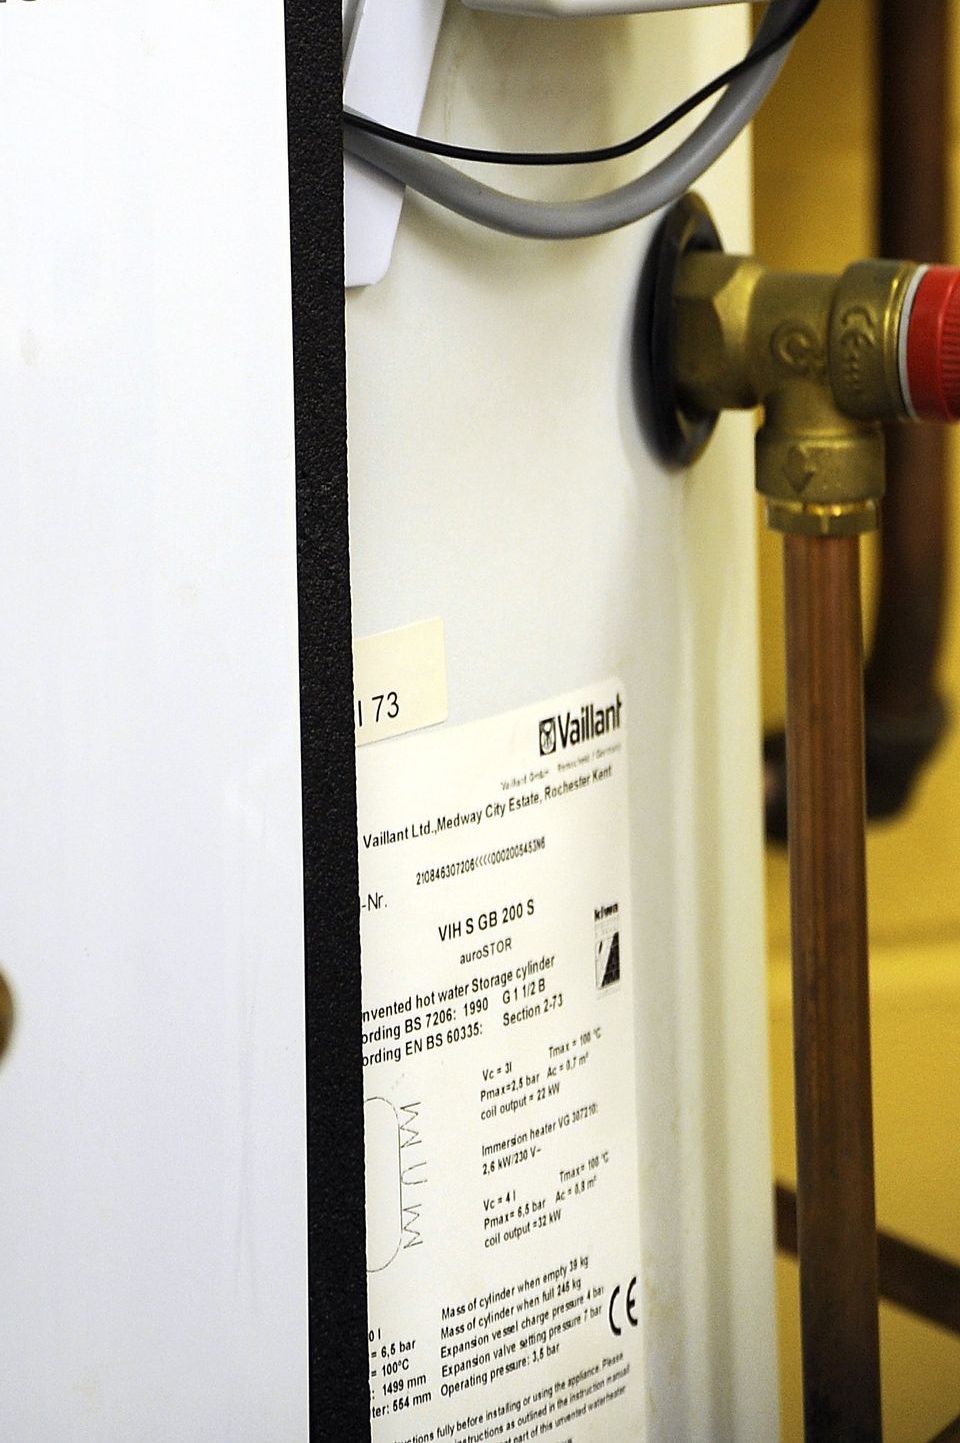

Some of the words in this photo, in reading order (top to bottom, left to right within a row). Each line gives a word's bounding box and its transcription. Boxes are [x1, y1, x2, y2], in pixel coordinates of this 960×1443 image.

[371, 691, 399, 723] 73
[557, 692, 622, 749] Vaillant
[363, 827, 409, 848] Vaillant
[485, 802, 506, 819] City
[509, 792, 542, 812] Estate,
[545, 775, 590, 800] Rochester
[592, 765, 612, 783] Kent
[438, 921, 461, 942] VIH
[465, 918, 474, 935] S
[478, 911, 498, 931] GB
[502, 903, 523, 923] 200
[527, 898, 535, 915] S
[460, 938, 512, 965] auroSTOR
[415, 991, 435, 1010] hot
[438, 984, 469, 1003] water
[471, 970, 513, 992] Storage
[516, 955, 555, 980] cylinder
[502, 990, 511, 1005] G
[514, 987, 518, 1001] 1
[522, 981, 535, 998] 1/2
[538, 978, 546, 993] B
[404, 1016, 422, 1034] BS
[426, 1007, 456, 1028] 7206:
[464, 997, 488, 1017] 1990
[503, 1004, 540, 1027] Section
[543, 993, 563, 1013] 2-73
[405, 1038, 423, 1056] EN
[426, 1033, 443, 1050] BS
[482, 1068, 495, 1081] Vc
[526, 1073, 540, 1087] bar
[481, 1105, 497, 1120] coil
[500, 1096, 527, 1114] output
[481, 1134, 528, 1157] Immersion
[530, 1121, 556, 1140] heater
[558, 1114, 570, 1129] VG
[483, 1199, 495, 1211] Vc
[532, 1198, 546, 1213] bar
[484, 1233, 501, 1248] coil
[503, 1222, 531, 1242] output
[441, 1305, 466, 1321] Mass
[468, 1297, 477, 1312] of
[480, 1286, 515, 1309] cylinder
[517, 1277, 540, 1293] when
[542, 1265, 567, 1283] empty
[580, 1256, 589, 1269] kg
[440, 1324, 465, 1340] Mass
[467, 1316, 476, 1331] of
[478, 1305, 514, 1329] cylinder
[516, 1295, 540, 1313] when
[542, 1287, 555, 1303] full
[572, 1278, 581, 1291] kg
[440, 1334, 489, 1359] Expansion
[492, 1320, 518, 1340] vessel
[521, 1311, 549, 1329] charge
[552, 1295, 584, 1320] pressure
[399, 1340, 416, 1353] bar
[441, 1353, 490, 1378] Expansion
[493, 1343, 516, 1360] valve
[520, 1331, 546, 1349] setting
[548, 1316, 581, 1340] pressure
[382, 1379, 404, 1397] 1499
[407, 1374, 427, 1390] mm
[440, 1373, 488, 1398] Operating
[546, 1343, 559, 1356] bar
[412, 1391, 432, 1407] mm
[437, 1424, 455, 1438] fully
[457, 1415, 483, 1431] before
[486, 1400, 521, 1420] installing
[523, 1397, 531, 1406] or
[533, 1387, 553, 1402] using
[554, 1381, 565, 1393] the
[506, 1421, 515, 1431] as
[517, 1405, 547, 1427] outlined
[556, 1397, 568, 1409] the
[531, 1426, 538, 1438] of
[540, 1421, 553, 1434] this
